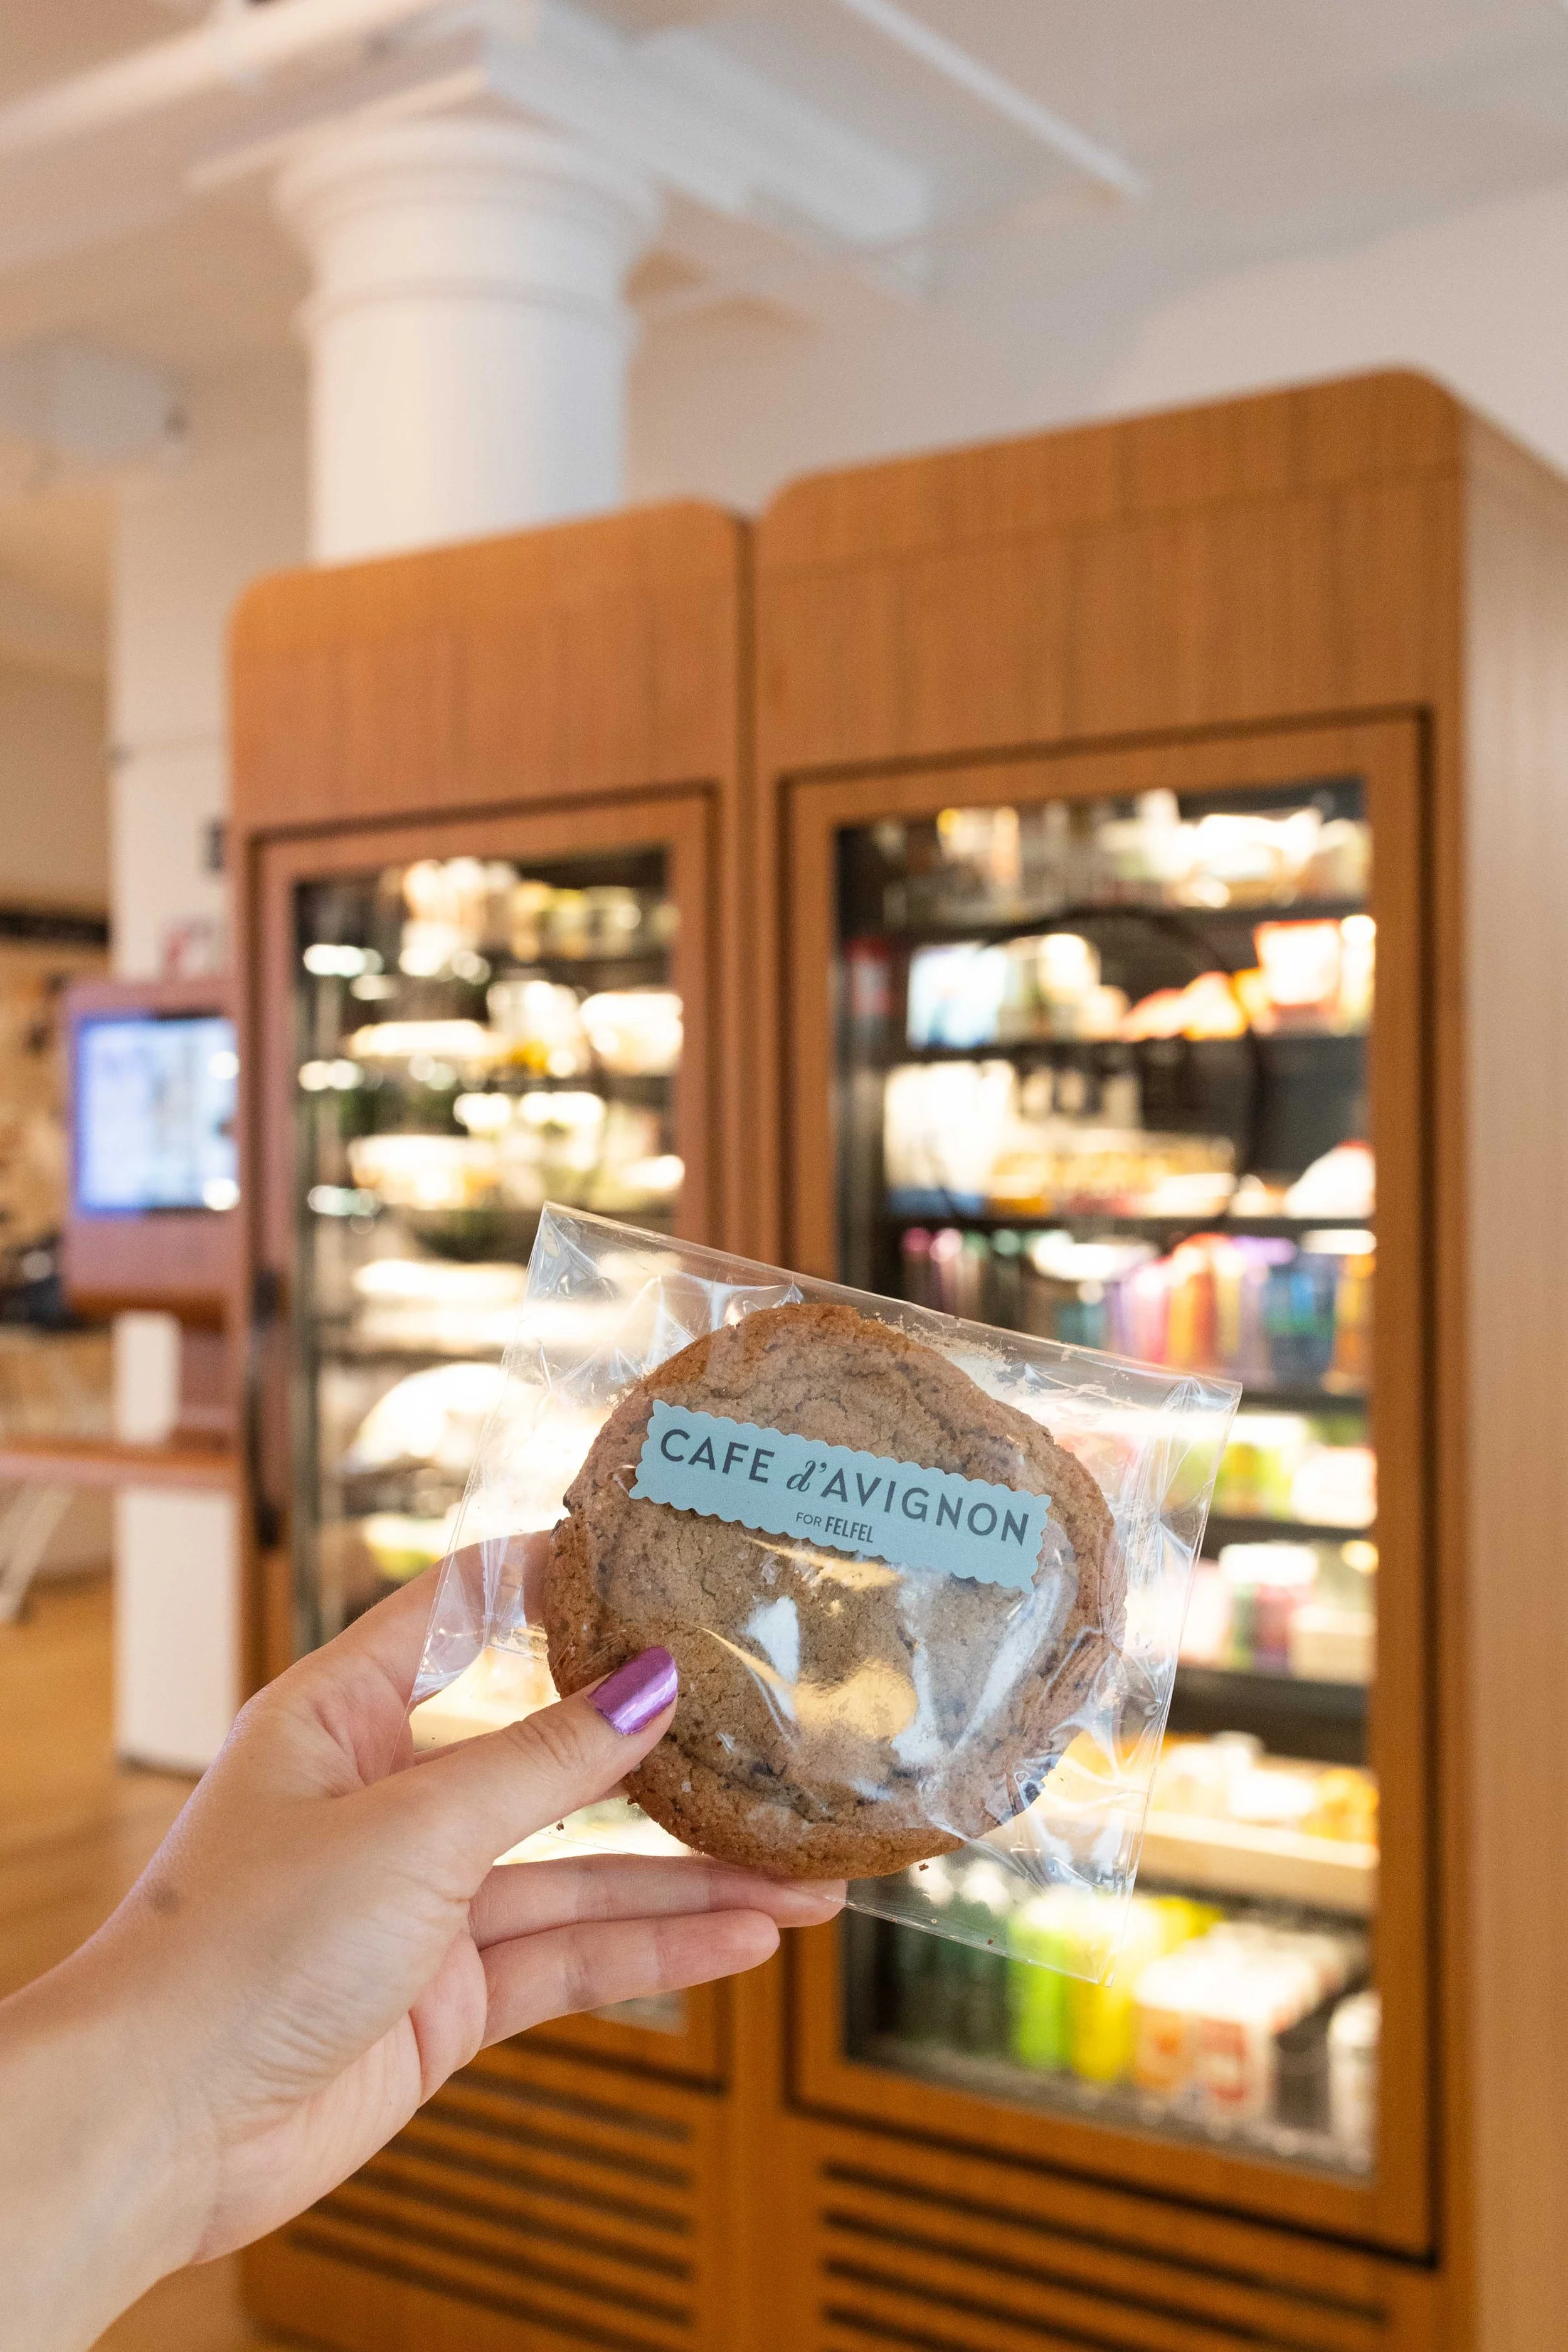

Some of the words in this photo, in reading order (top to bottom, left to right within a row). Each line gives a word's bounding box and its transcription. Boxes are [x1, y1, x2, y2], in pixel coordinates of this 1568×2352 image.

[660, 1429, 775, 1483] CAFE
[786, 1460, 1029, 1546] d'AVIGNON
[795, 1512, 822, 1528] FOR
[825, 1515, 874, 1544] FELFEL
